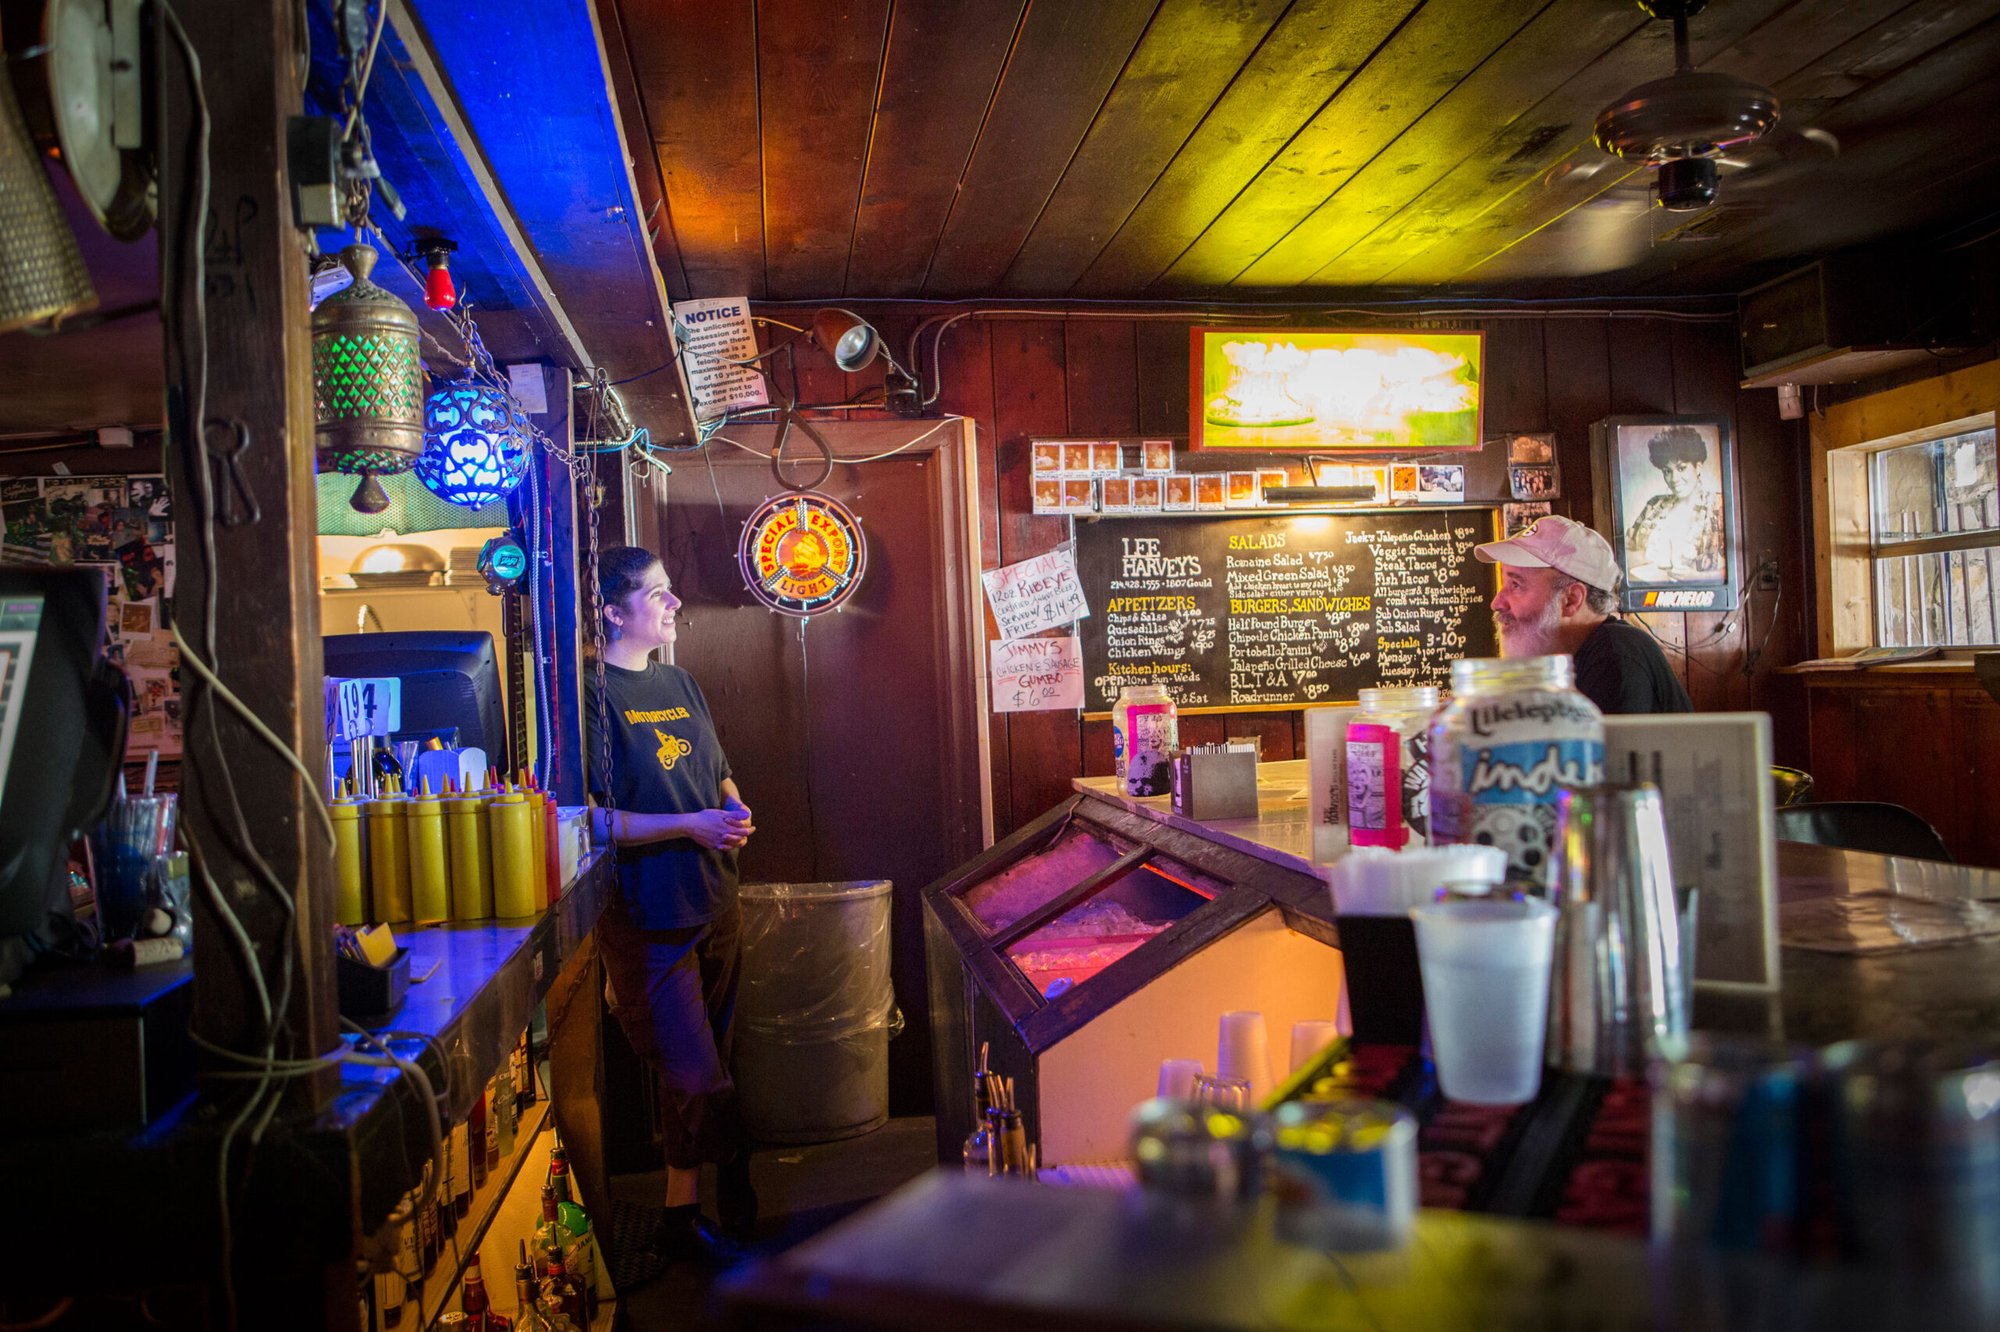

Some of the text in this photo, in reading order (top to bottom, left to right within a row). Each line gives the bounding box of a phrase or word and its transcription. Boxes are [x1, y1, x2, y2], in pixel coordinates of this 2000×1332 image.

[685, 306, 741, 324] NOTICE
[703, 319, 745, 332] unlicensed
[689, 331, 730, 343] ossession
[730, 335, 751, 344] these
[692, 365, 727, 375] maximum
[726, 370, 747, 378] years
[695, 374, 759, 391] imprisonment and
[712, 388, 727, 396] fine
[761, 514, 844, 573] SPECIAL EXPORT
[1229, 532, 1287, 550] SALADS
[1413, 529, 1451, 542] Chicken
[1122, 537, 1161, 558] LEE
[1369, 544, 1406, 561] Veggie
[1409, 544, 1455, 556] Sandwich
[1122, 555, 1202, 578] HARVEY'S
[1226, 555, 1271, 568] Romaine
[1273, 553, 1303, 566] Salad
[1374, 558, 1405, 572] Steak
[1405, 556, 1437, 570] Tacos
[991, 555, 1065, 590] SPECIAL
[1226, 570, 1262, 583] Mixed
[1263, 570, 1298, 581] Green
[1299, 567, 1329, 580] Salad
[1374, 572, 1398, 586] Fish
[1399, 570, 1429, 584] Tacos
[780, 577, 828, 595] LIGHT
[1017, 569, 1073, 598] RIBEYE
[1110, 578, 1213, 590] 214.428.1555 1807 Gould
[1374, 586, 1387, 597] All
[1425, 584, 1476, 596] sandwiches
[1270, 589, 1295, 598] either
[1386, 594, 1484, 606] come with French Fries
[1655, 591, 1715, 608] MICHELOB
[1107, 596, 1196, 613] APPETIZERS
[1292, 596, 1371, 613] SANDWICHES
[1108, 613, 1132, 625] Chips
[1140, 611, 1167, 622] Salsa
[1375, 606, 1392, 620] Sub
[1392, 607, 1418, 619] Onion
[1419, 607, 1444, 624] Rings
[1003, 620, 1038, 639] FRIES
[1107, 623, 1168, 635] Quesadillas
[1228, 617, 1250, 631] Half
[1251, 616, 1279, 629] Pound
[1280, 615, 1317, 632] Burger
[1375, 620, 1392, 634] Sub
[1394, 619, 1421, 633] Salad
[1108, 636, 1136, 647] Onion
[1138, 635, 1165, 648] Rings
[1229, 630, 1268, 646] Chipotle
[1270, 629, 1311, 641] Chicken
[1311, 627, 1343, 640] Panini
[1108, 647, 1151, 658] Chicken
[1151, 645, 1186, 659] Wings
[1229, 643, 1280, 658] Portobello
[1280, 642, 1312, 656] Panini
[1377, 649, 1417, 665] Monday:
[1436, 647, 1465, 661] Tacos
[996, 663, 1033, 678] CHICKEN
[1044, 657, 1080, 673] SAUSAGE
[1108, 661, 1192, 675] Kitchen hours:
[1230, 658, 1274, 674] Jalapeño
[1275, 657, 1309, 670] Grilled
[1311, 656, 1348, 668] Cheese
[1378, 662, 1453, 680] Tuesday: price
[1018, 674, 1063, 688] GUMBO
[1266, 671, 1276, 687] &
[1276, 671, 1288, 686] A
[1181, 692, 1208, 704] & Sat
[1230, 689, 1295, 704] Roadrunner
